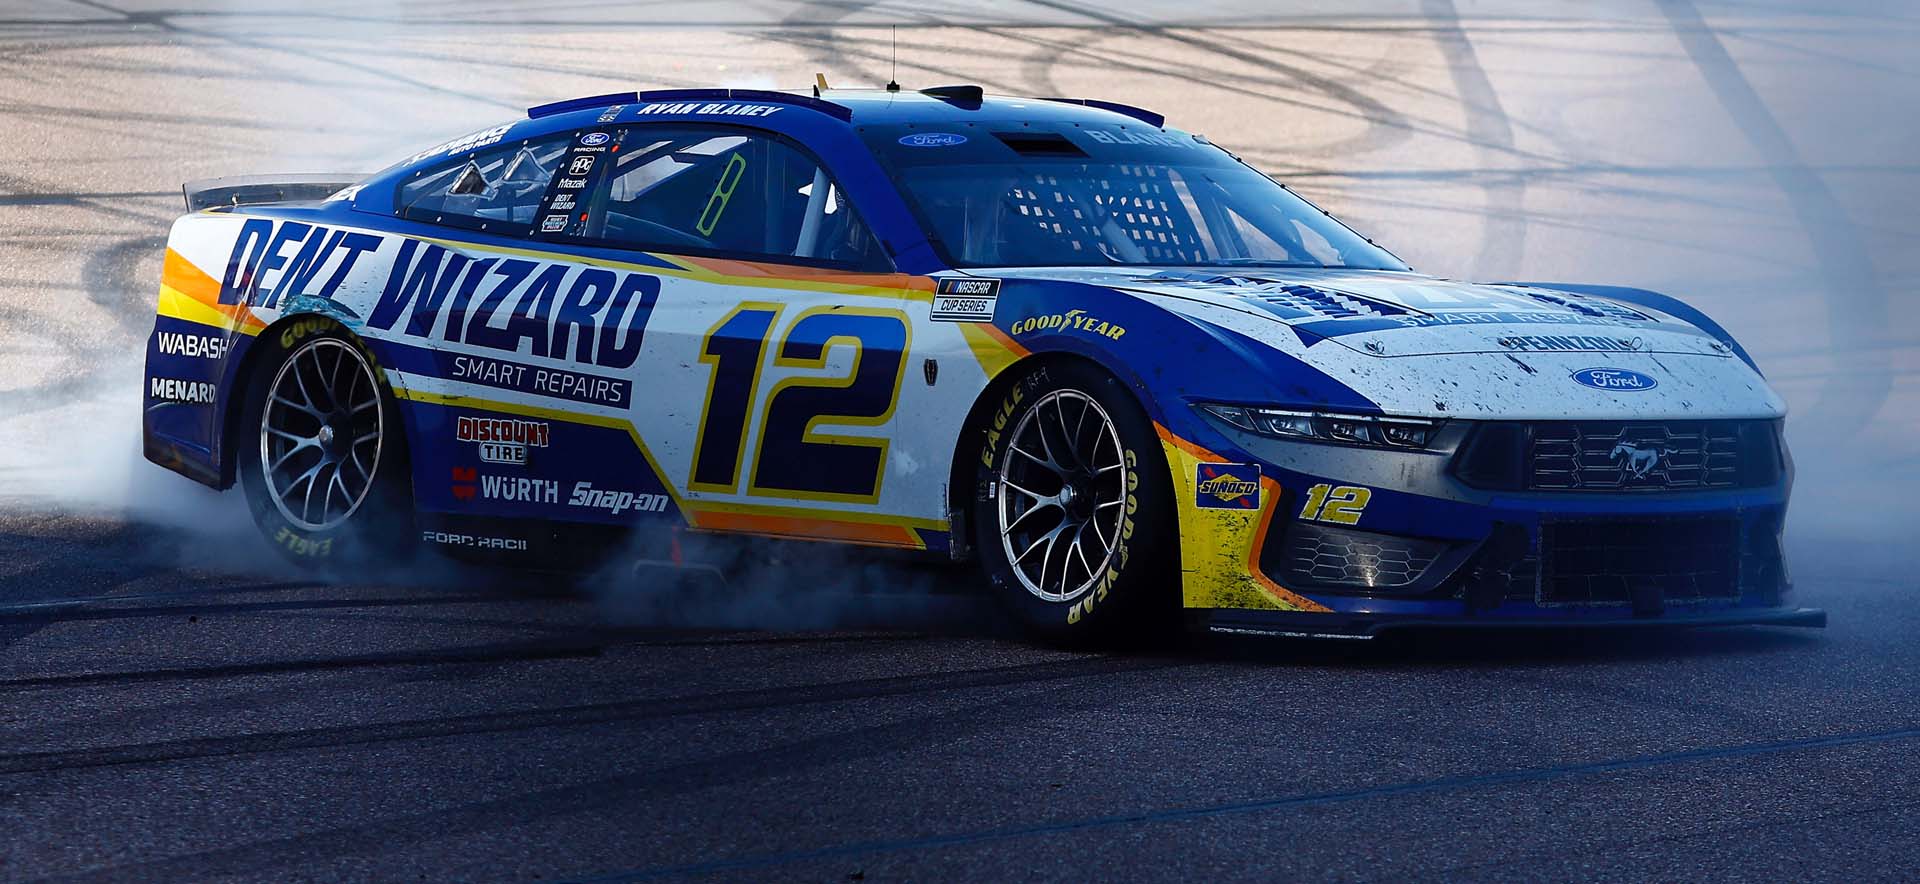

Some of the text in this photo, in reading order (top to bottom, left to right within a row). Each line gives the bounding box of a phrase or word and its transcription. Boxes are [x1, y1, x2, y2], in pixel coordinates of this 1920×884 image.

[637, 103, 702, 115] RYAN
[696, 103, 785, 117] BLANEY
[583, 133, 607, 144] Ford
[907, 133, 960, 146] Ford
[558, 178, 587, 188] Mazak
[549, 202, 576, 210] WIZARD
[554, 194, 573, 202] DENT
[217, 218, 661, 369] DENT WIZARD
[955, 281, 992, 295] NASCAR
[940, 299, 988, 312] CUP SERIES
[1394, 312, 1503, 329] SMART
[158, 331, 231, 360] WABASH
[1510, 335, 1636, 351] PENNZOIL
[452, 356, 624, 403] SMART REPAIRS
[1582, 368, 1651, 390] Ford
[686, 301, 913, 505] 12
[456, 416, 550, 447] DISCOUNT
[981, 381, 1025, 469] EAGLE
[483, 444, 526, 461] TIRE
[481, 474, 559, 504] WÜRTH
[1200, 481, 1258, 495] SUNOCO
[568, 481, 669, 514] Snap-on
[1298, 483, 1372, 526] 12
[423, 531, 474, 546] FORD
